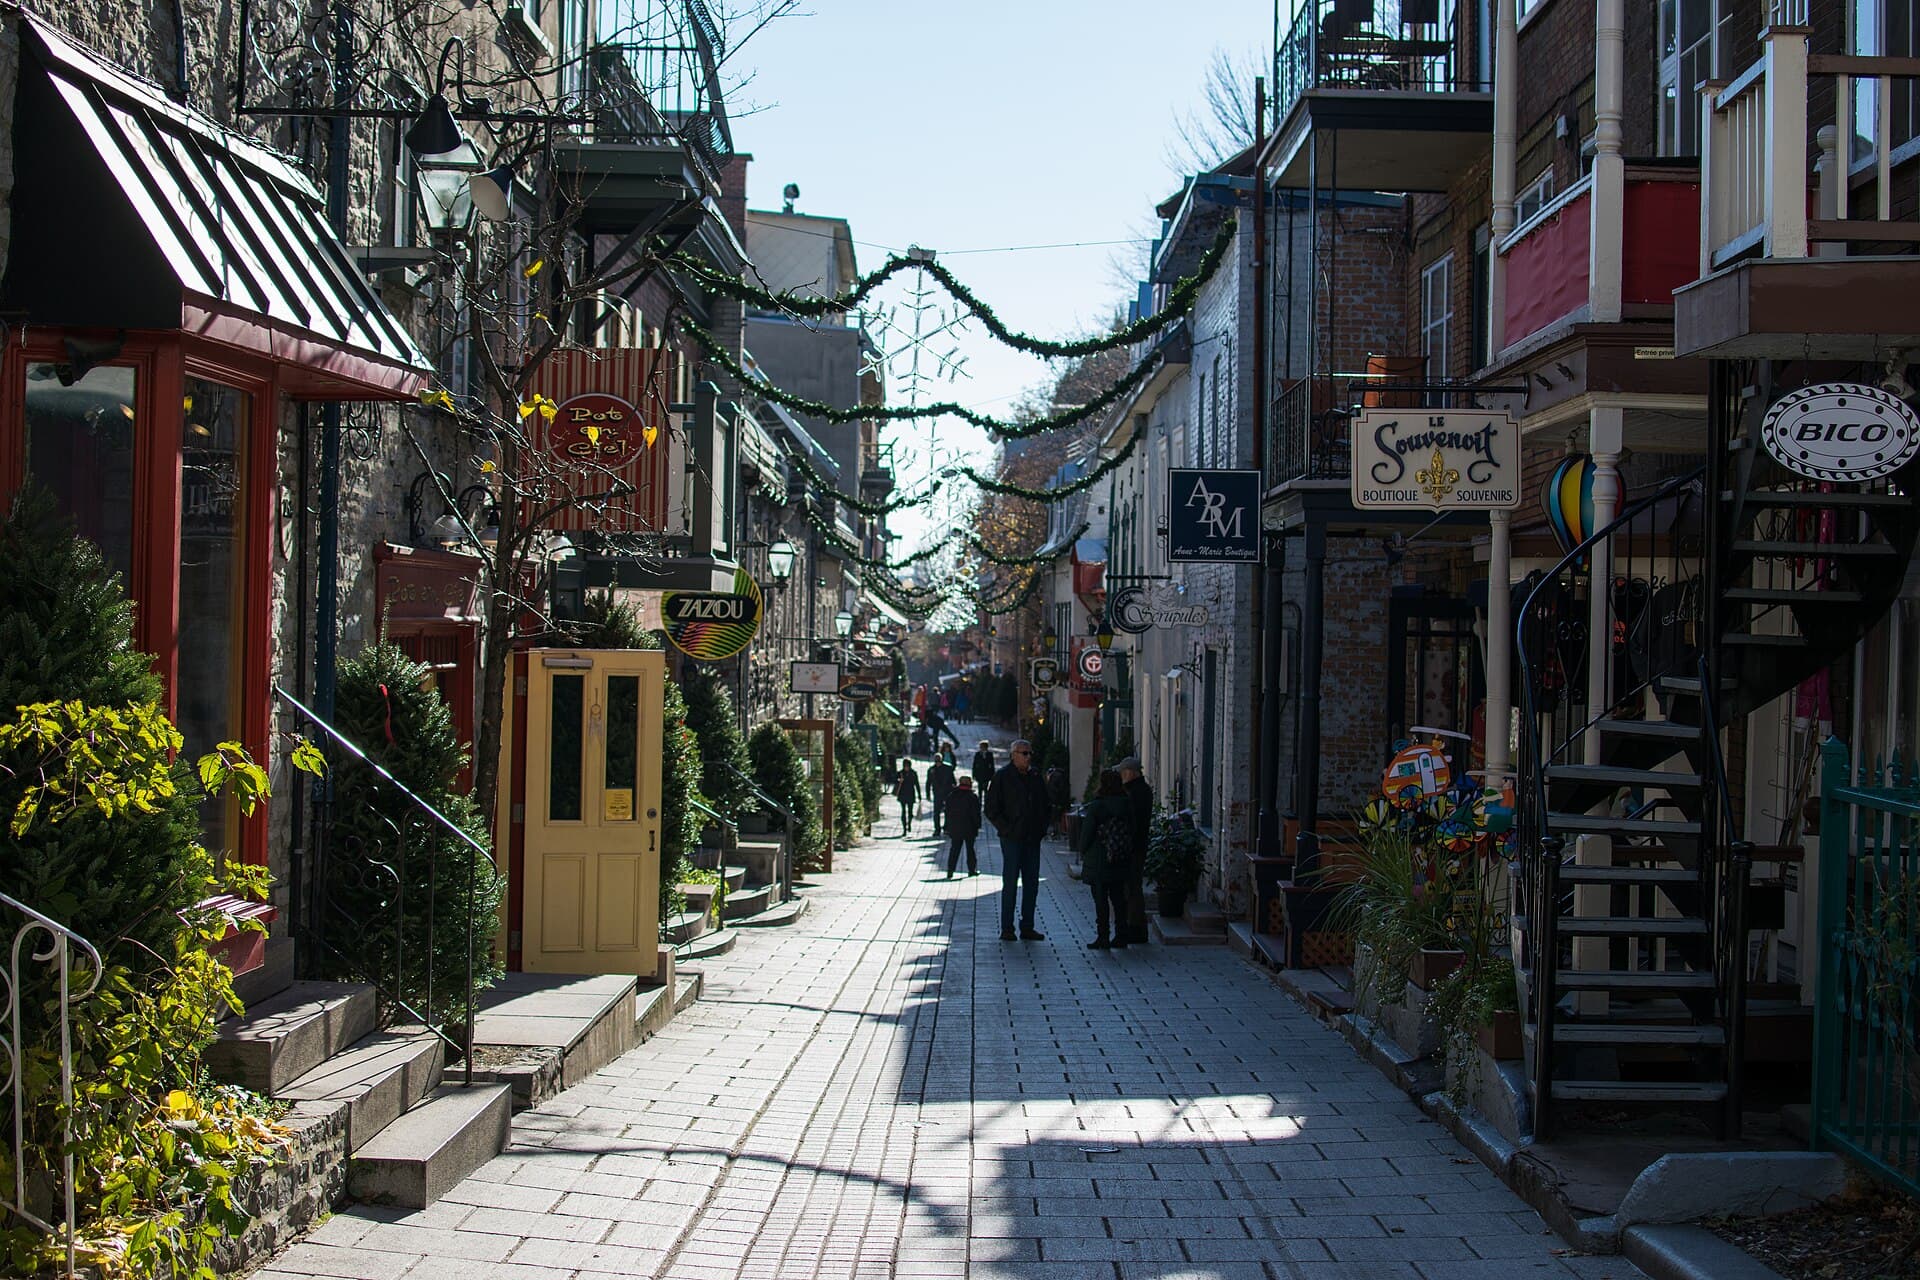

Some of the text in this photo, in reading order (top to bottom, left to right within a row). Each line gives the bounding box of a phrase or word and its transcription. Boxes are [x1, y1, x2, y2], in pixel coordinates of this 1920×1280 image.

[568, 406, 624, 421] Pot
[1428, 416, 1445, 427] LE
[1795, 423, 1888, 442] BICO
[567, 439, 627, 456] Ciel
[1363, 490, 1513, 502] BOUTIQUE SOUVENIRS
[1224, 546, 1257, 559] Boutique
[676, 598, 744, 619] ZAZOU
[1128, 606, 1206, 629] Scrupules
